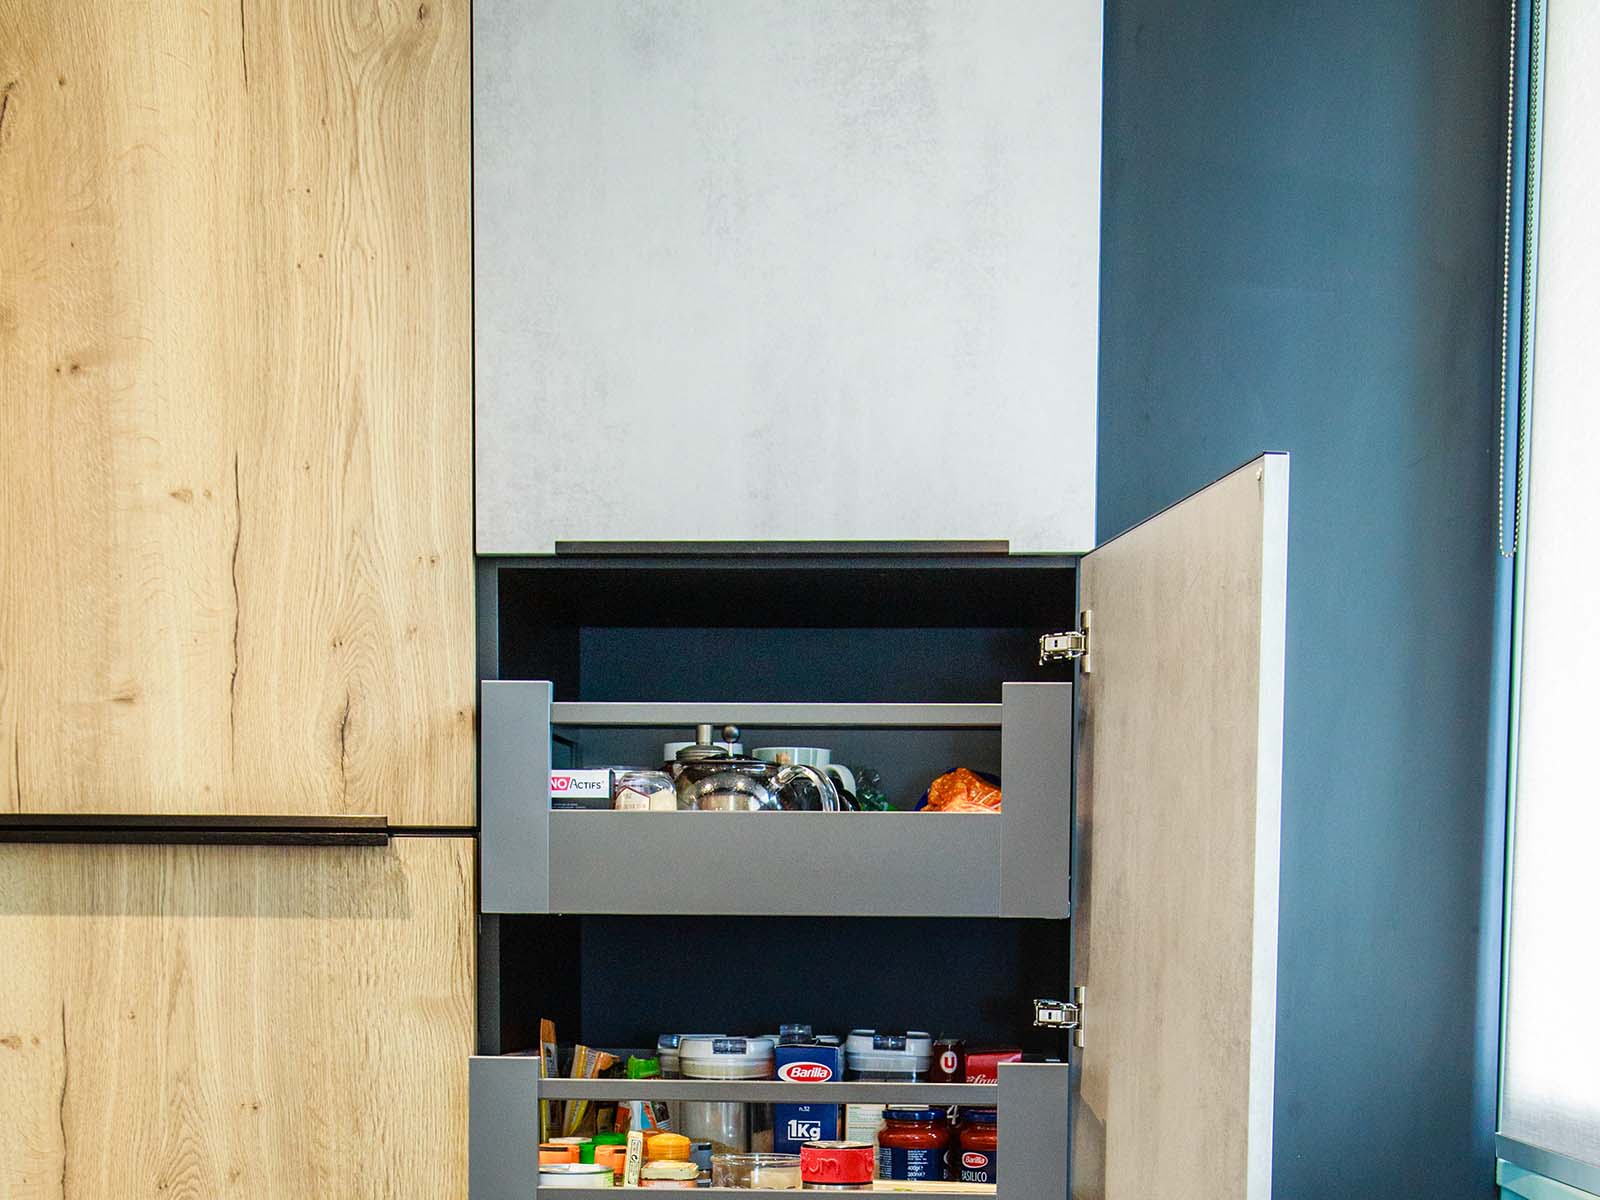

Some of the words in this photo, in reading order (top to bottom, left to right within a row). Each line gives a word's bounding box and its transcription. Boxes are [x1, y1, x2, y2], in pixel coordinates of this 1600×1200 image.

[943, 1056, 955, 1069] U
[790, 1066, 829, 1079] Barilla
[787, 1119, 821, 1141] 1Kg
[964, 1153, 986, 1165] Barilla
